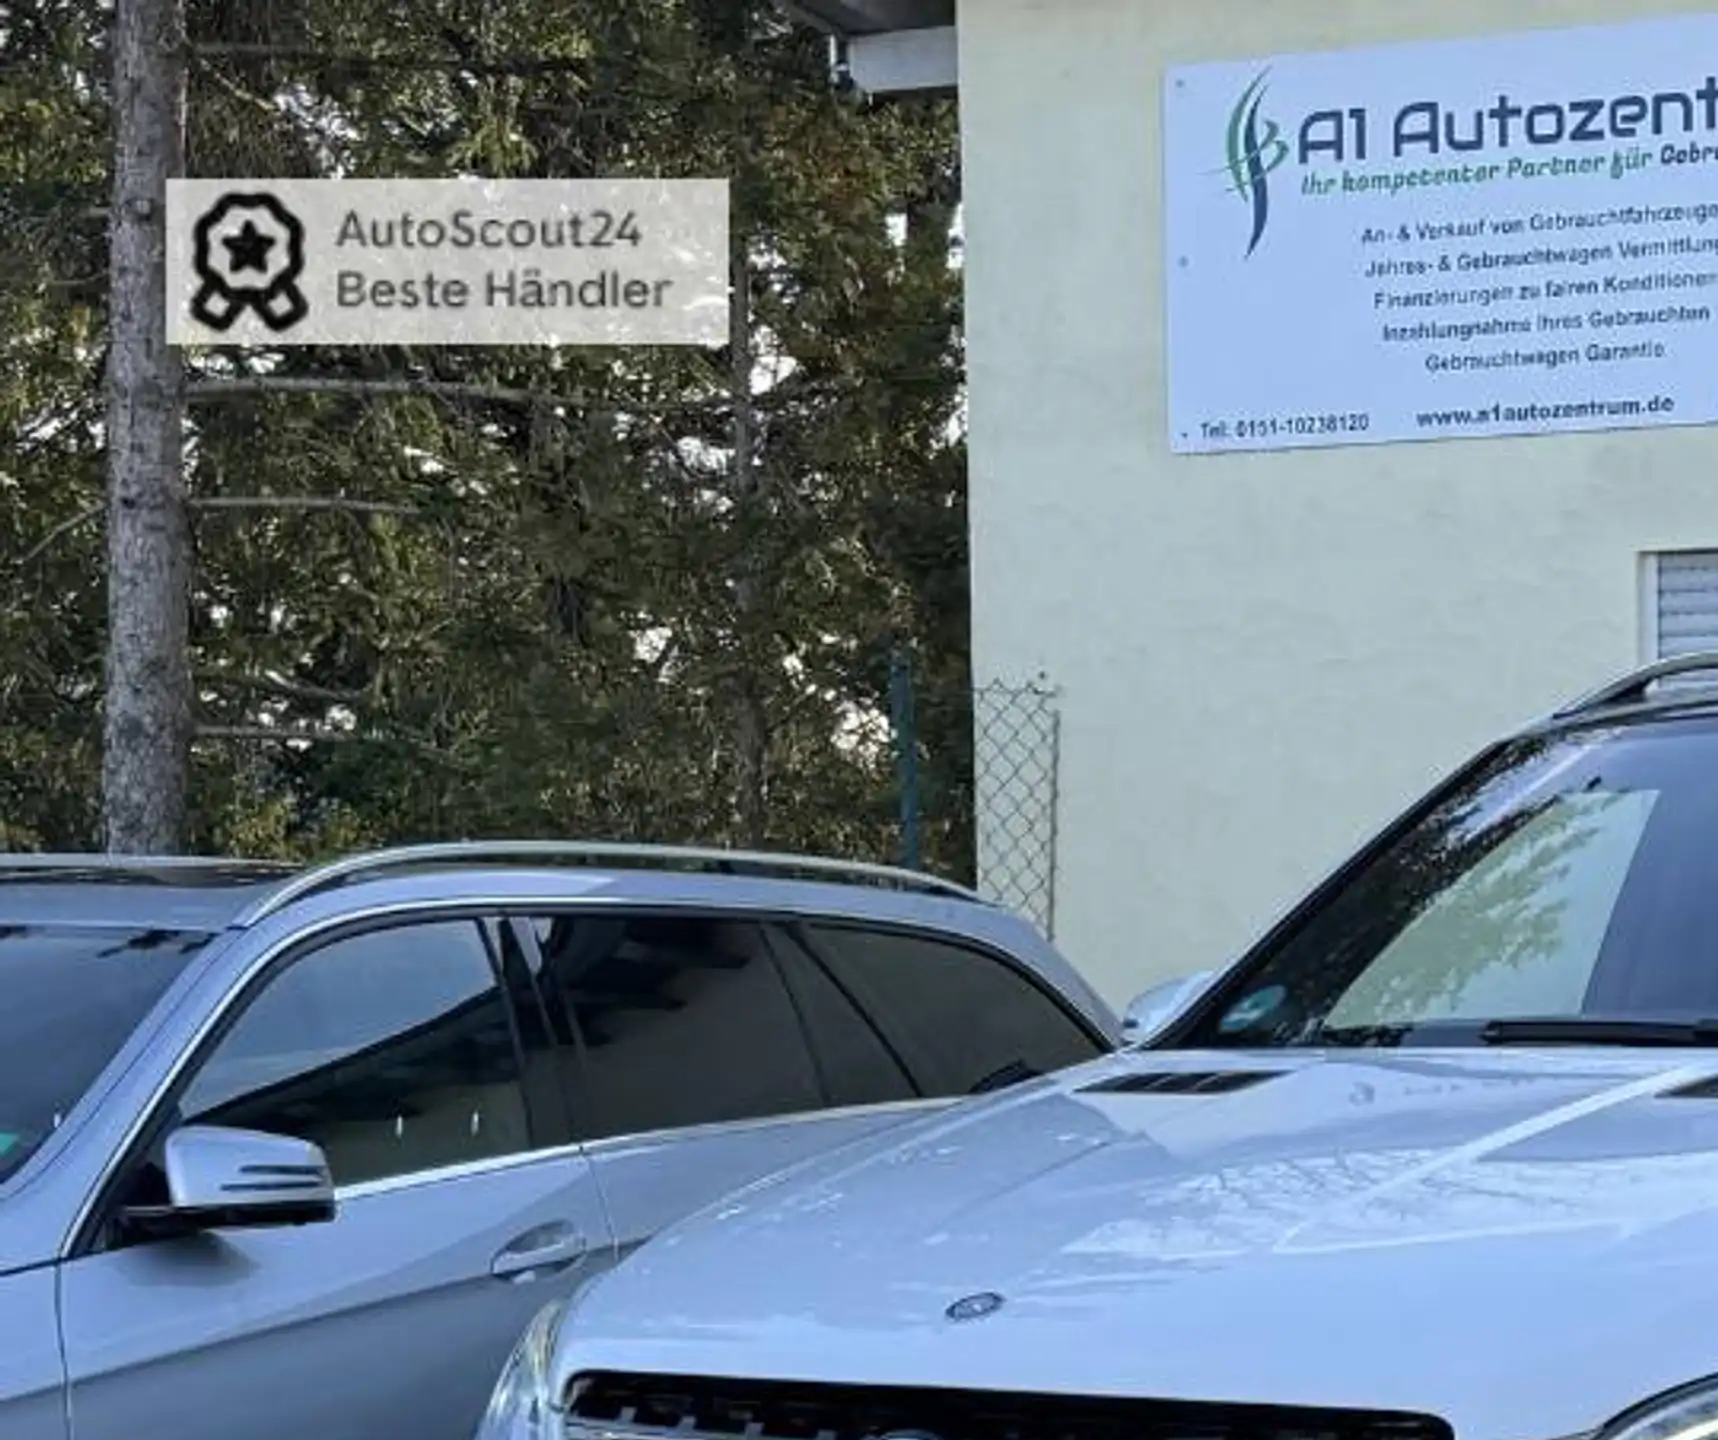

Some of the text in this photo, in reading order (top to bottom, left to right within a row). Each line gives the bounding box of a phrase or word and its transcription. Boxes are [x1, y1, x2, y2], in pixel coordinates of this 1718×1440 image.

[1298, 108, 1366, 164] A1
[1301, 172, 1335, 196] Ihr
[1341, 163, 1499, 196] kompetenter
[1507, 154, 1605, 180] Partner
[1609, 147, 1652, 180] für
[1438, 254, 1452, 272] &
[1416, 395, 1675, 427] www.a1autozentrum.de
